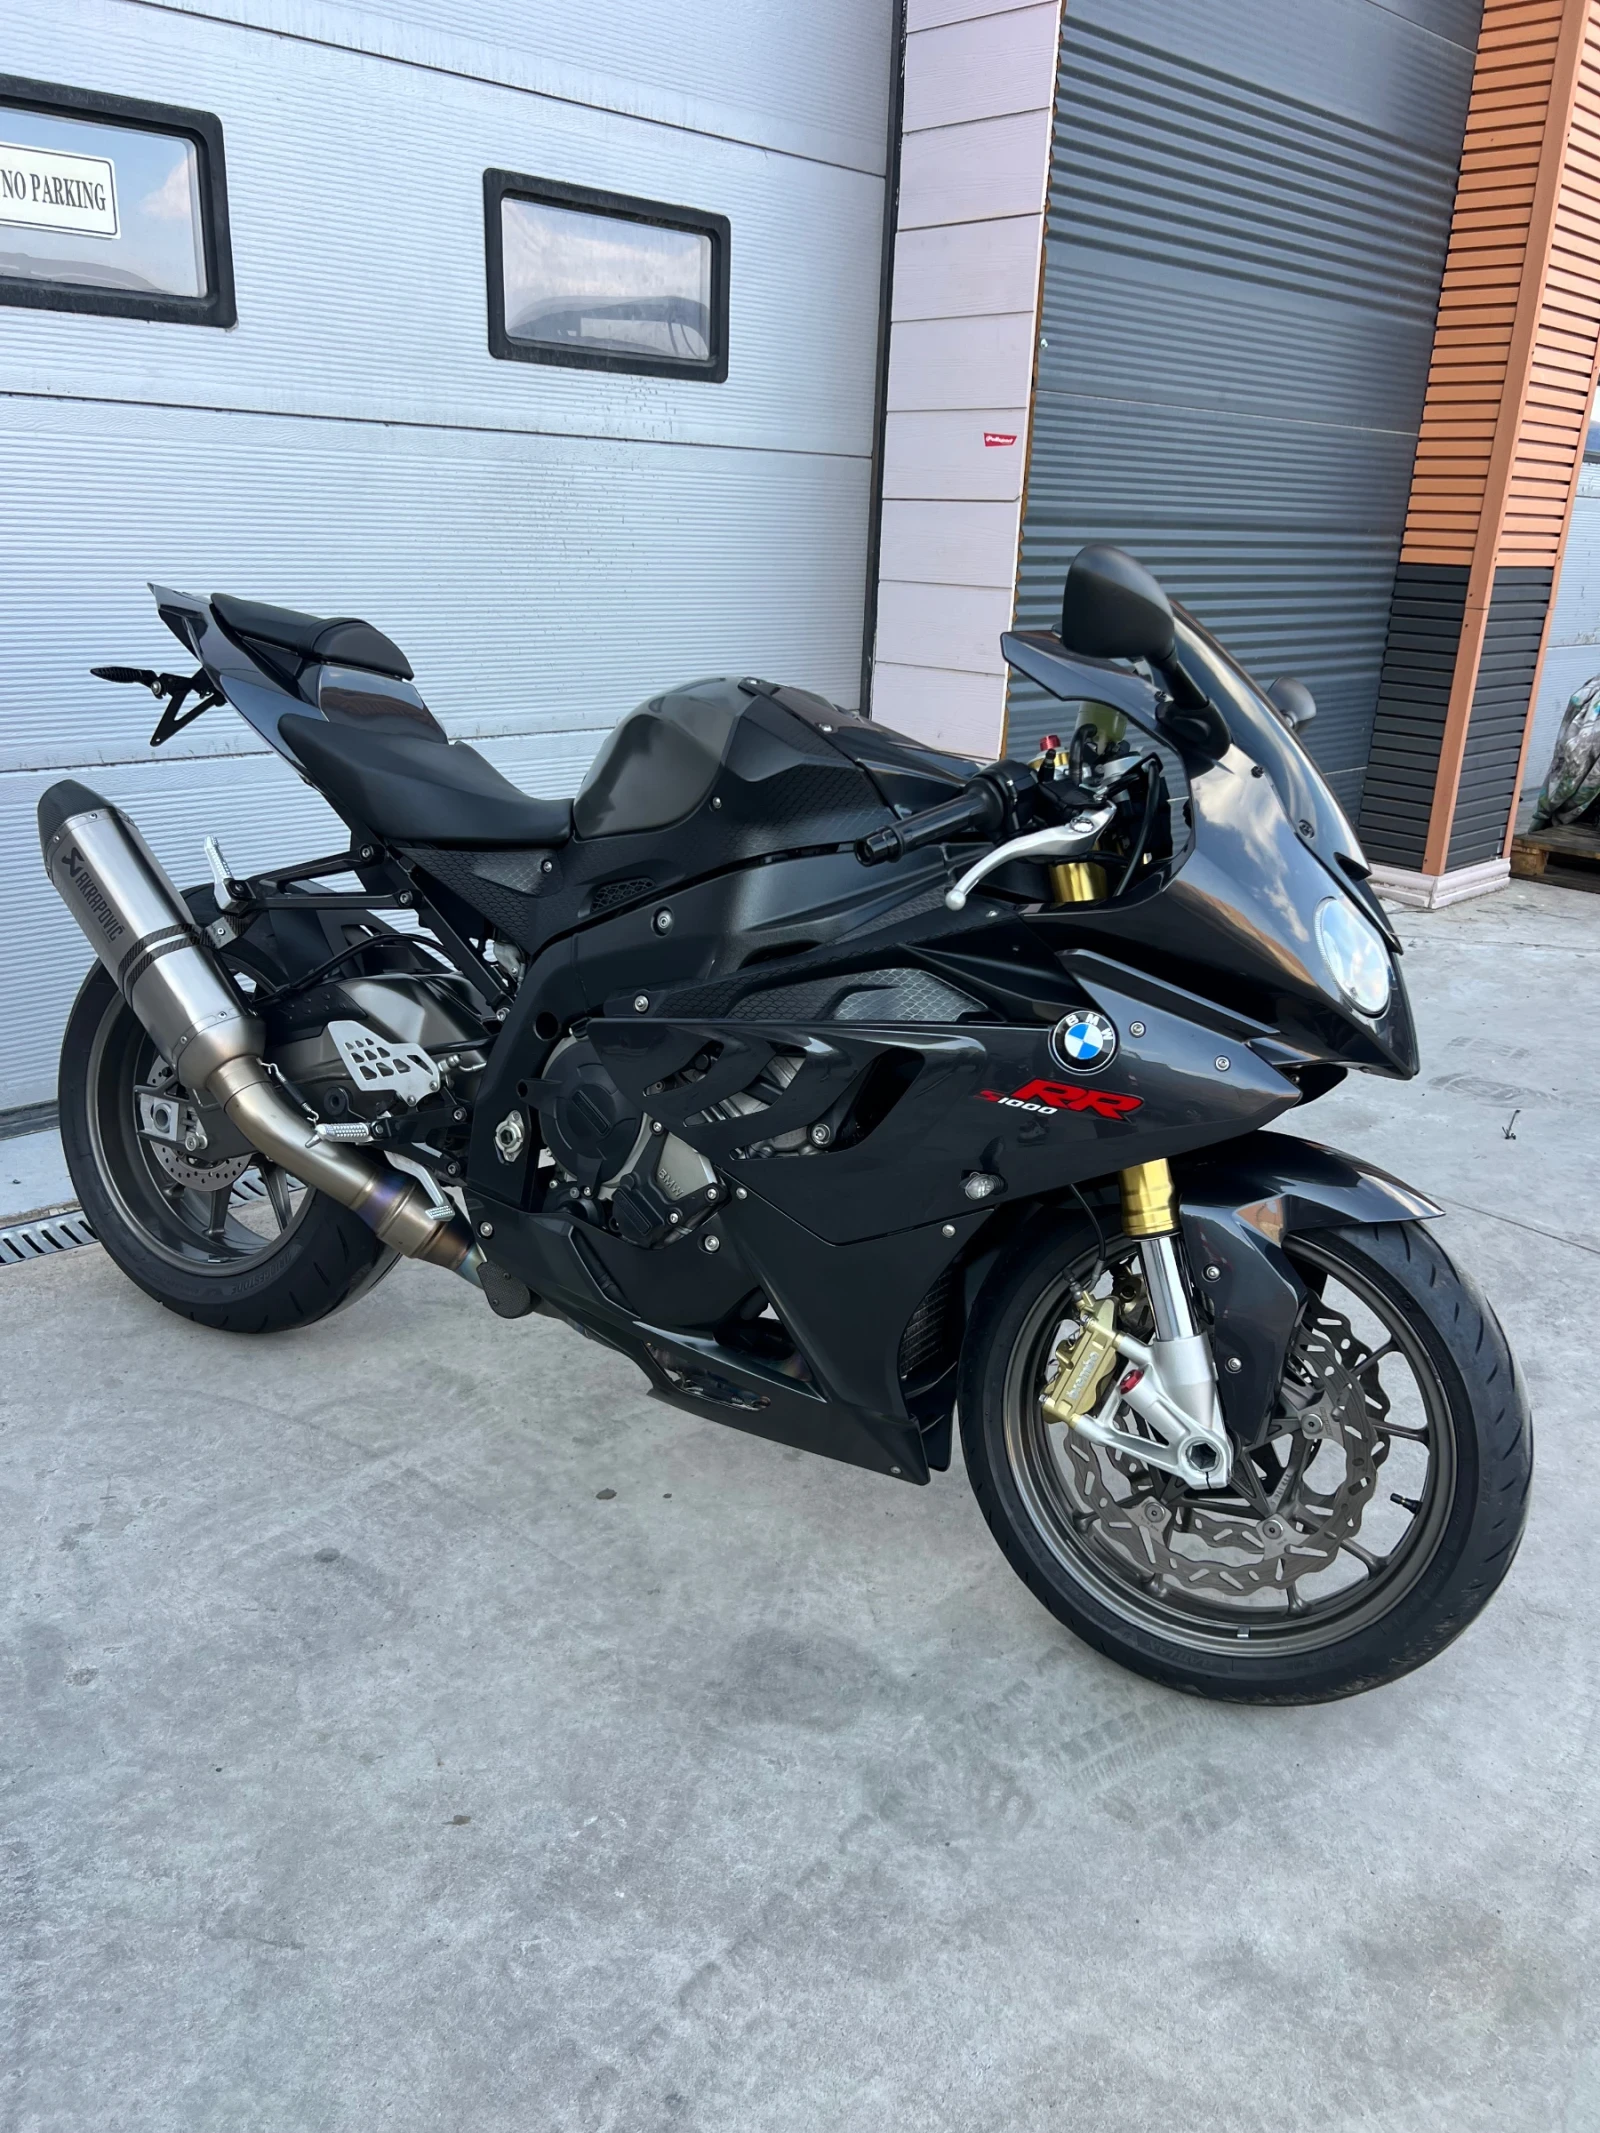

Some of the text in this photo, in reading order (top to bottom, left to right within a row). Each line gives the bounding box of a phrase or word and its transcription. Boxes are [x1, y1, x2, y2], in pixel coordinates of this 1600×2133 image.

[0, 169, 107, 211] NO PARKING
[75, 871, 126, 942] AKRAPOVIČ
[1065, 1013, 1115, 1041] BMW
[1010, 1077, 1144, 1121] RR
[658, 1168, 685, 1197] BMW
[1066, 1350, 1100, 1400] brembo
